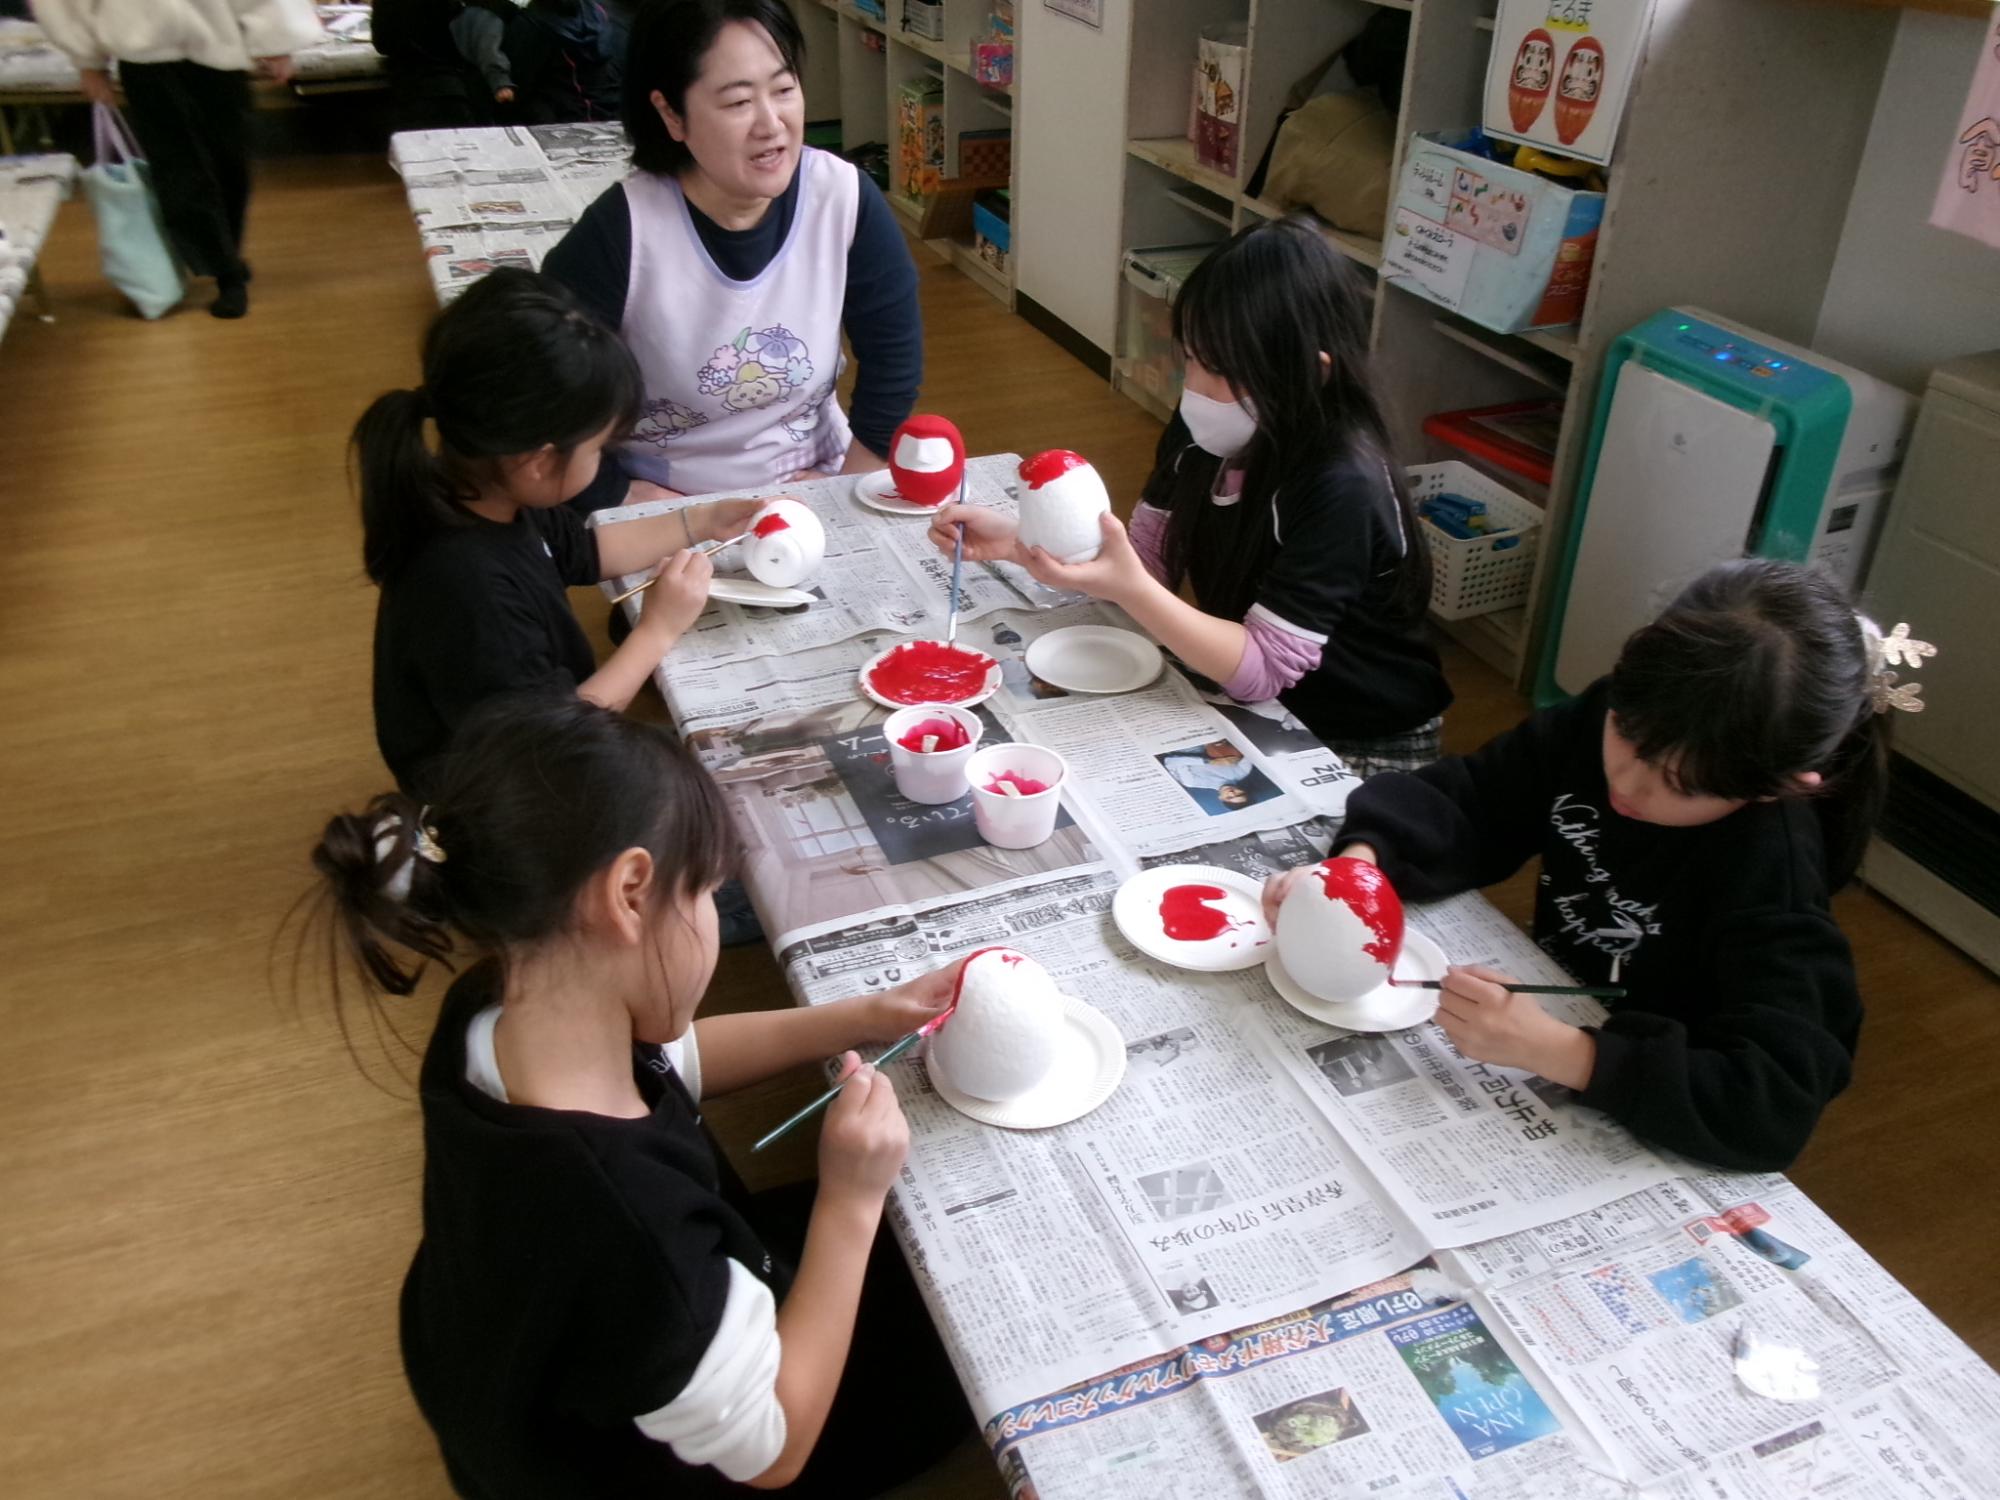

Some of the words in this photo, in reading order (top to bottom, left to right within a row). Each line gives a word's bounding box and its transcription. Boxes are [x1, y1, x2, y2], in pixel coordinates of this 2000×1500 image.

[1466, 1062, 1559, 1141] 抑止力向上
[987, 1316, 1336, 1442] 大谷翔平メモリアルグッズコレクシ
[1453, 1386, 1523, 1424] OPEN
[1472, 1407, 1525, 1438] ANA
